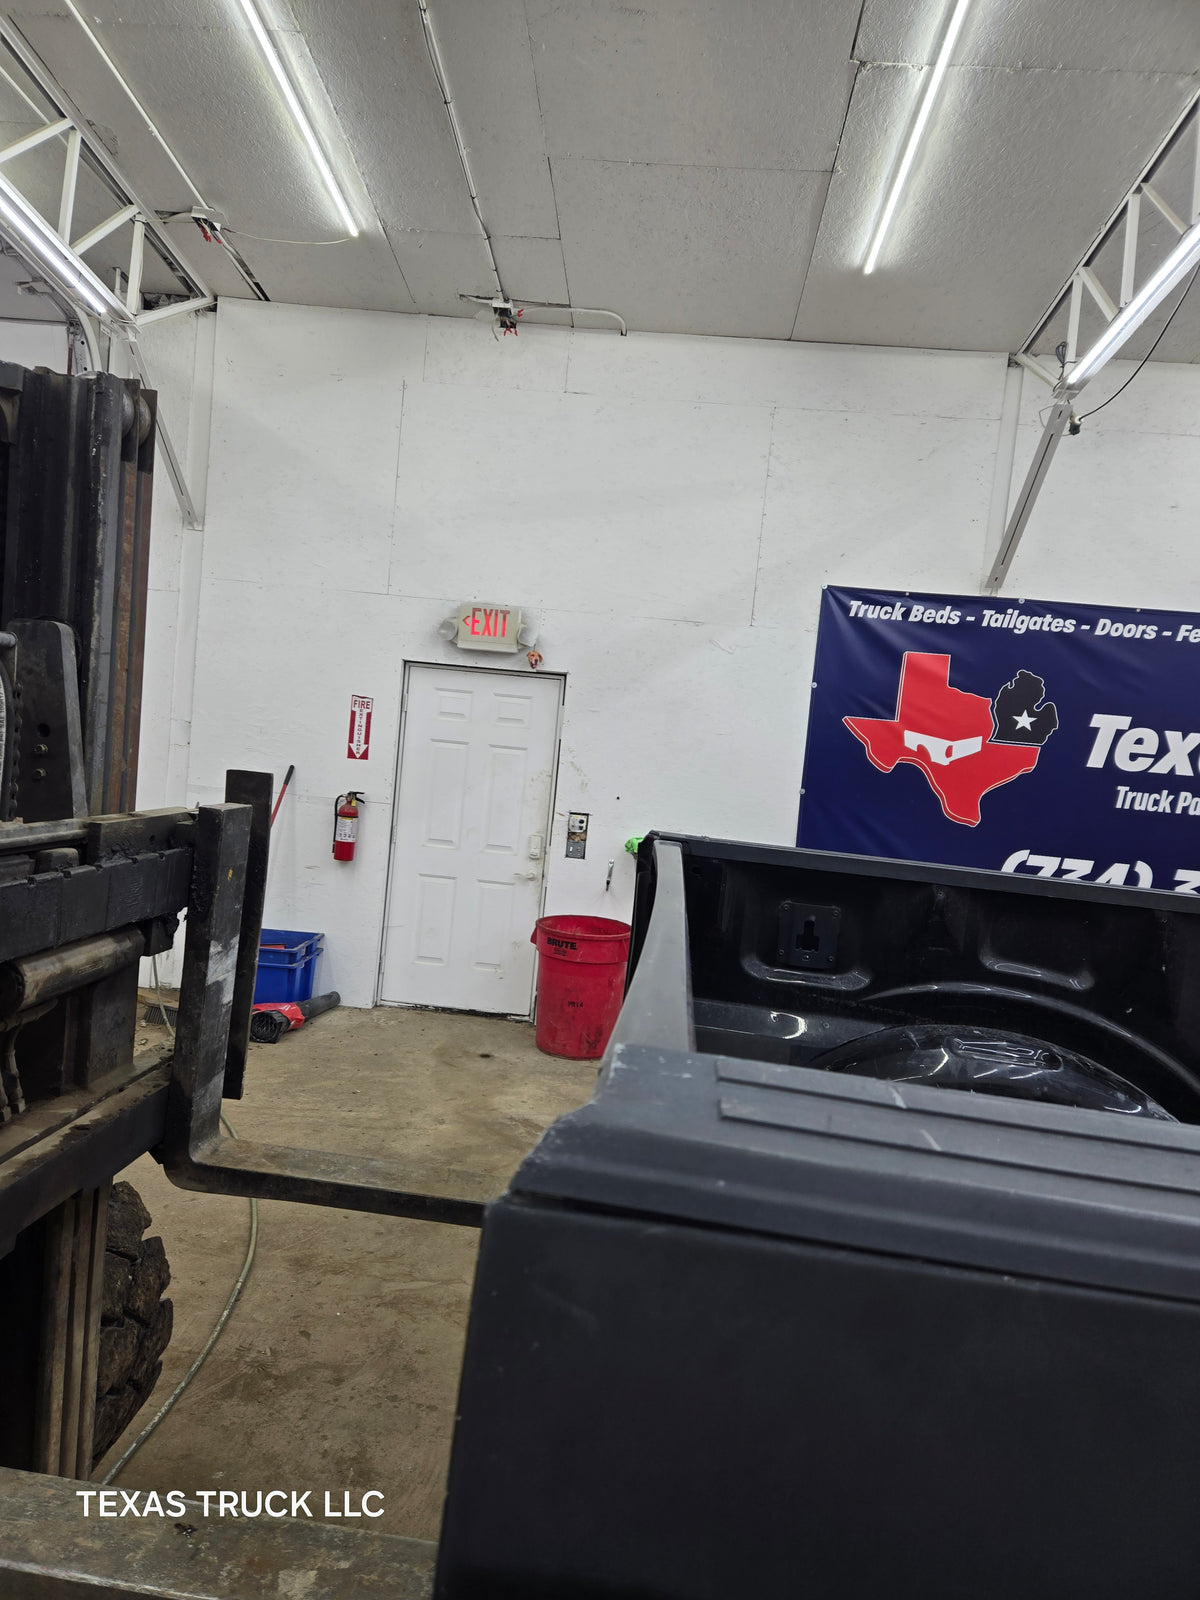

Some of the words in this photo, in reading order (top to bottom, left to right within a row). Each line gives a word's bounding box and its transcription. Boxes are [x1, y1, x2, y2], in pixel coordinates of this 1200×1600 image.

[470, 607, 511, 637] EXIT
[849, 600, 906, 621] Truck
[908, 605, 961, 625] Beds
[981, 609, 1077, 634] Tailgates
[1094, 618, 1158, 640] Doors
[1176, 625, 1200, 643] Fe
[353, 700, 371, 709] FIRE
[1086, 713, 1200, 777] Tex
[1115, 785, 1175, 813] Truck
[547, 937, 577, 950] BRUTE
